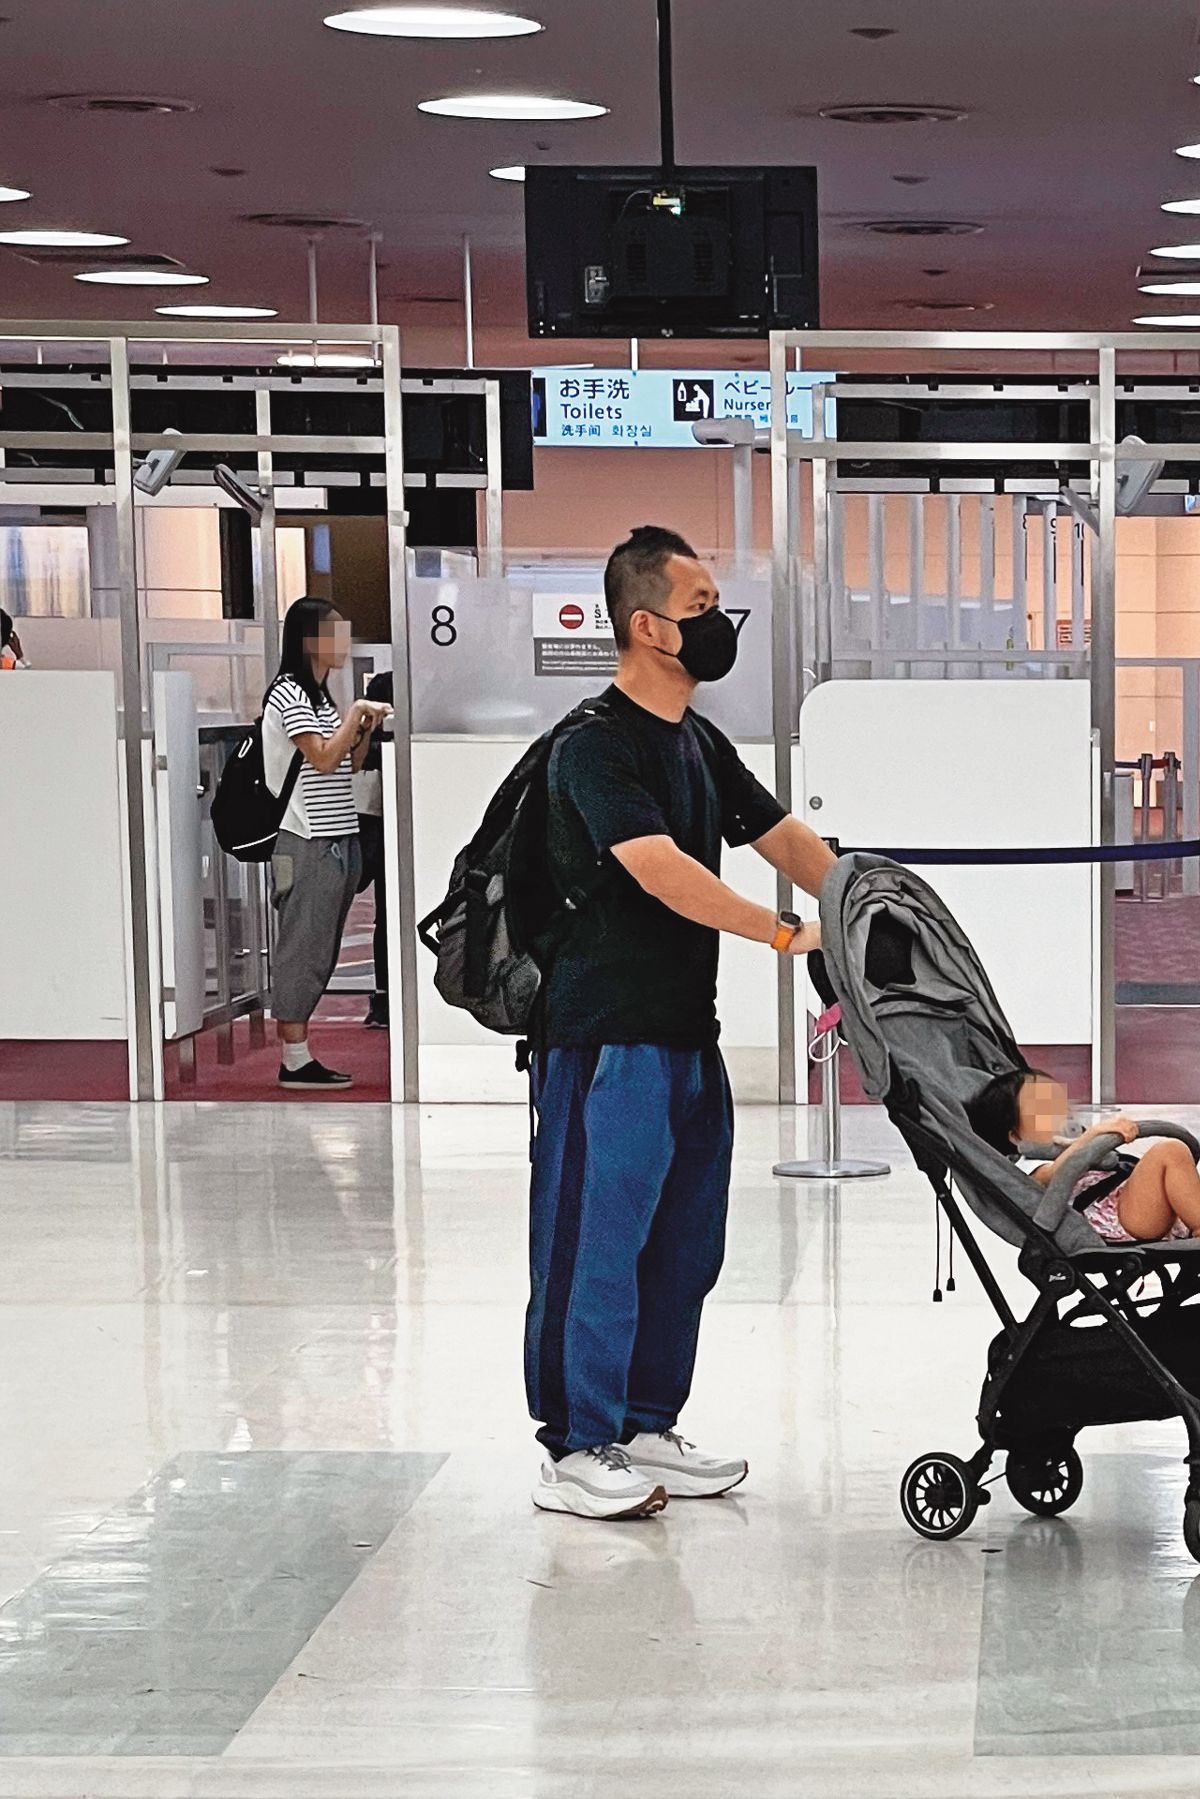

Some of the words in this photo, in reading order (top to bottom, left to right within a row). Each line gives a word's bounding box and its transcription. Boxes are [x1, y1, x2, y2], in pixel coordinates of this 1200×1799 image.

[560, 378, 630, 400] お手洗
[559, 402, 622, 419] Toilets
[723, 398, 771, 411] Nurser
[561, 424, 601, 437] 洗手间
[612, 424, 652, 438] 화장실
[430, 604, 457, 647] 8
